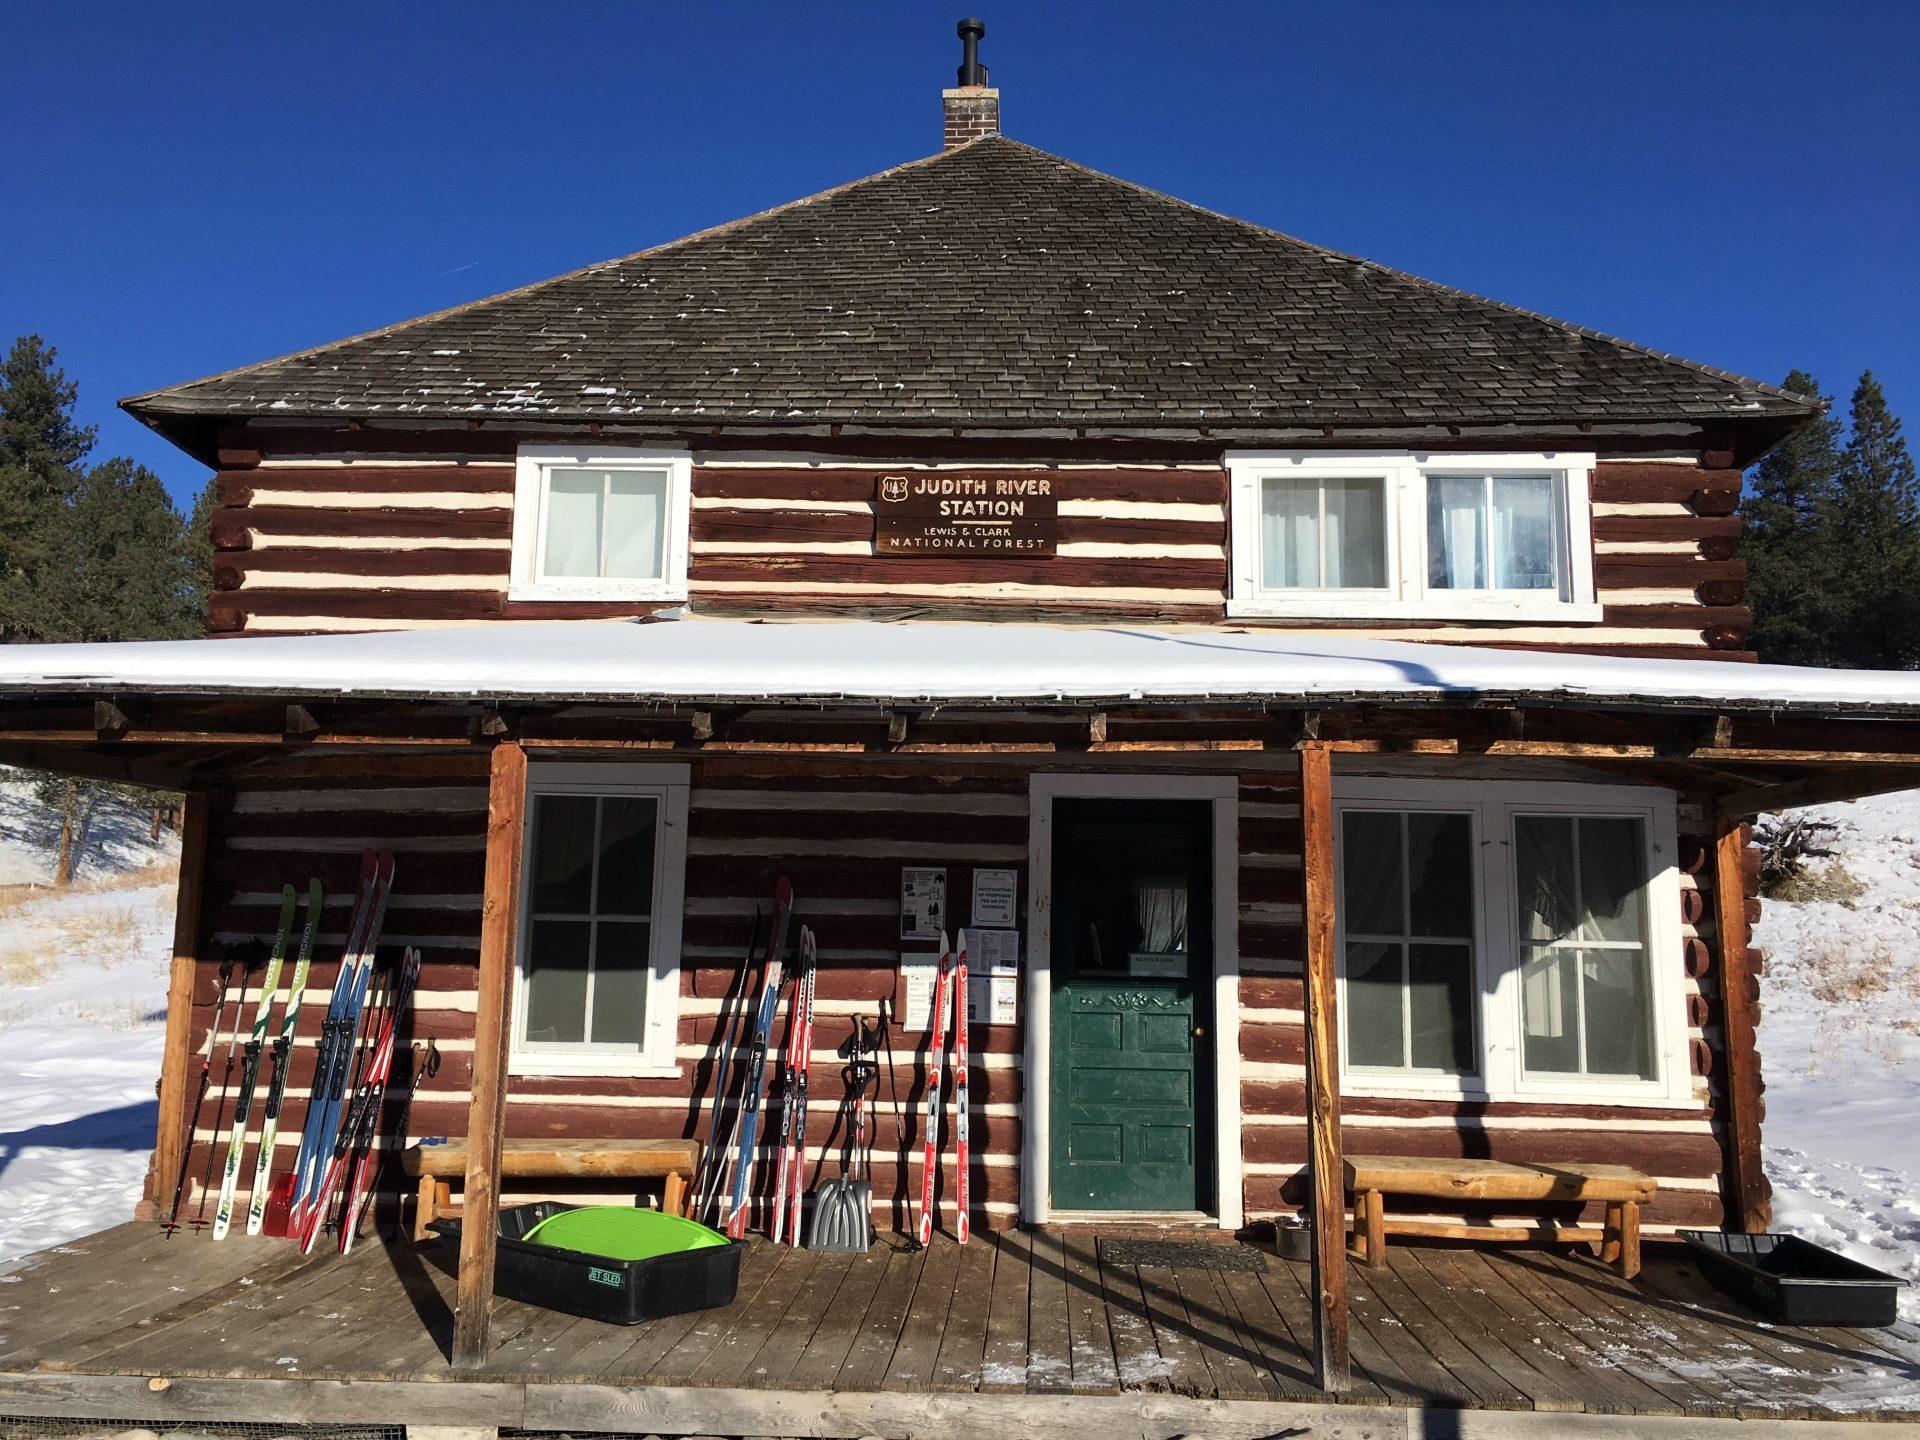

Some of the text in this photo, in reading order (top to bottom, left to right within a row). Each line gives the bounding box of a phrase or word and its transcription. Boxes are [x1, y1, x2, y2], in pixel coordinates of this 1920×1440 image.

[914, 479, 1051, 496] JUDITH RIVER
[939, 500, 1025, 517] STATION
[924, 527, 1011, 537] LEWIS & CLARK
[890, 538, 1045, 549] NATIONAL FOREST
[264, 927, 285, 989] ROSSIGNOL
[294, 921, 313, 984] ROSSIGNOL
[938, 982, 949, 1038] ROSSIGNOL
[960, 982, 968, 1034] ROSSIGNOL
[588, 1269, 620, 1285] JET SLED
